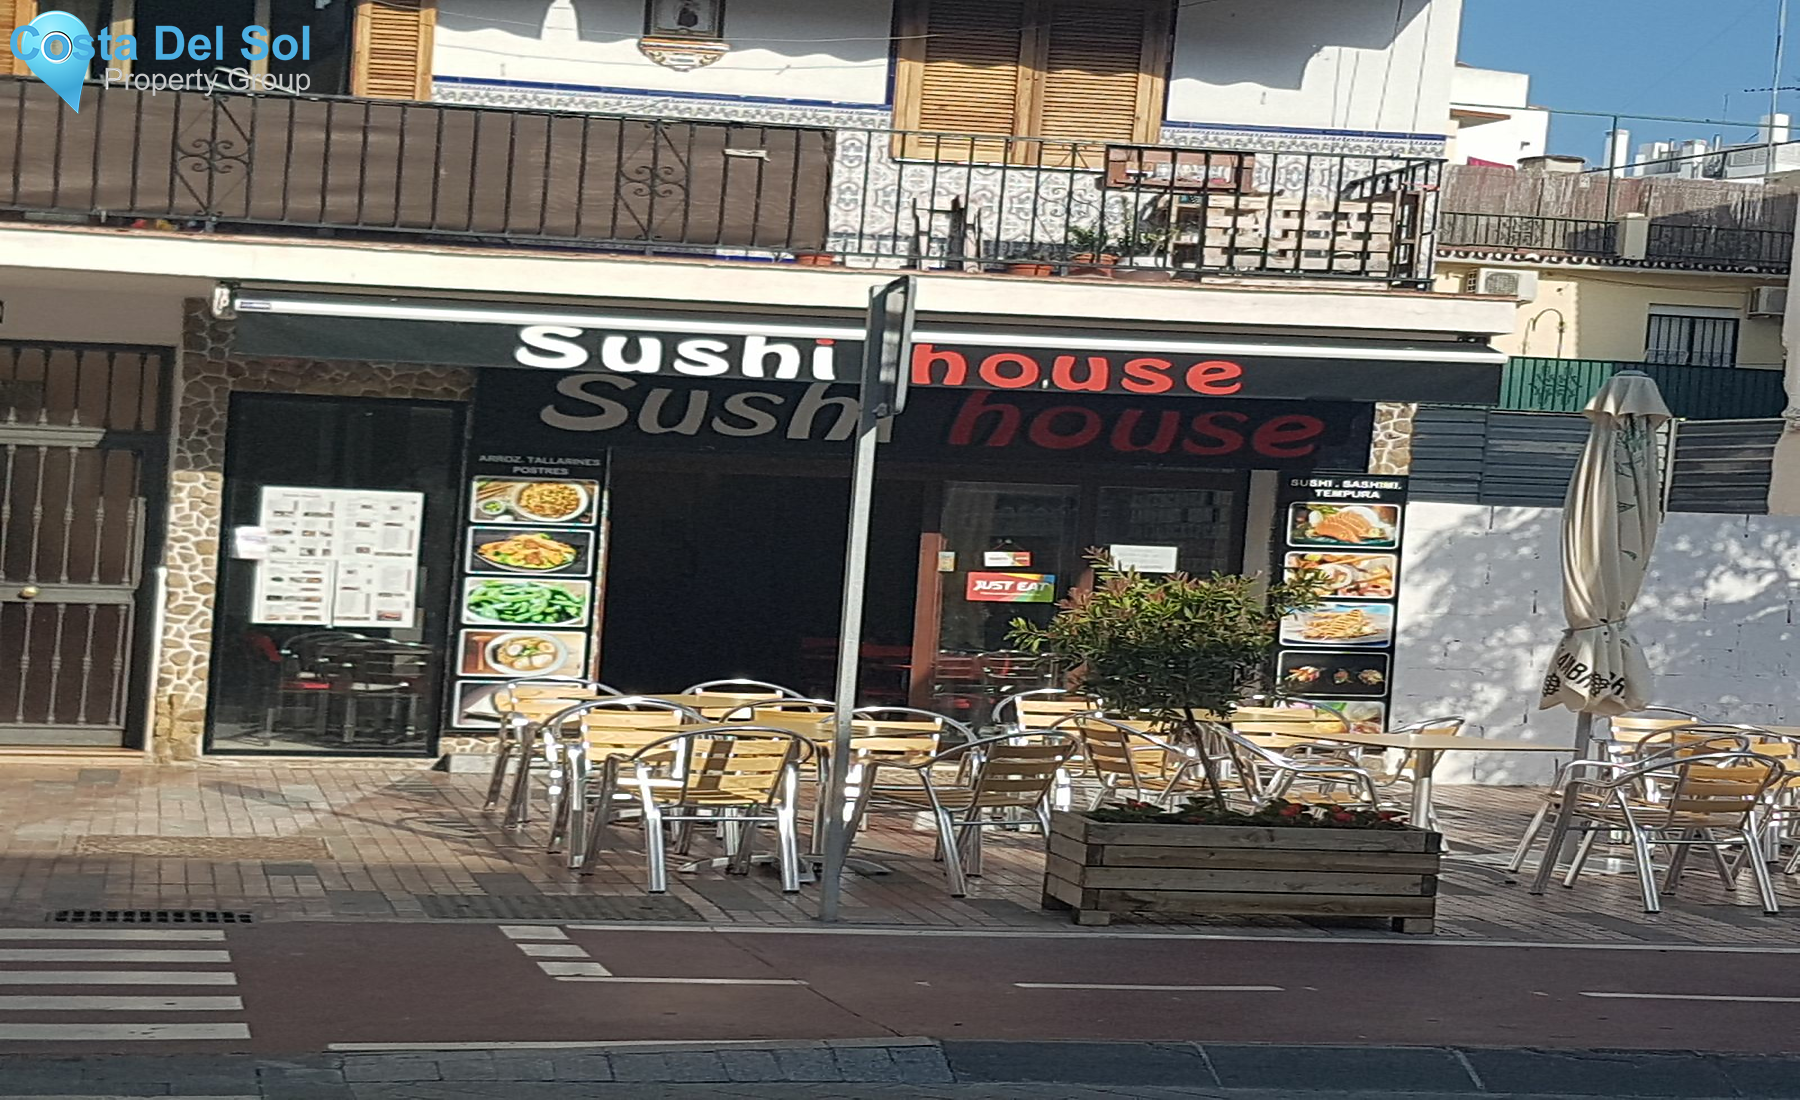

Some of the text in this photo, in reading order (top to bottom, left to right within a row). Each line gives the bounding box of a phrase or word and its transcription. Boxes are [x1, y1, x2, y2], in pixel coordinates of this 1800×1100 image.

[515, 325, 1243, 396] Sushi house
[948, 389, 1325, 459] house
[512, 466, 570, 475] POSTRES
[1314, 489, 1380, 499] TEMPURA
[973, 580, 1050, 592] JUST EAT
